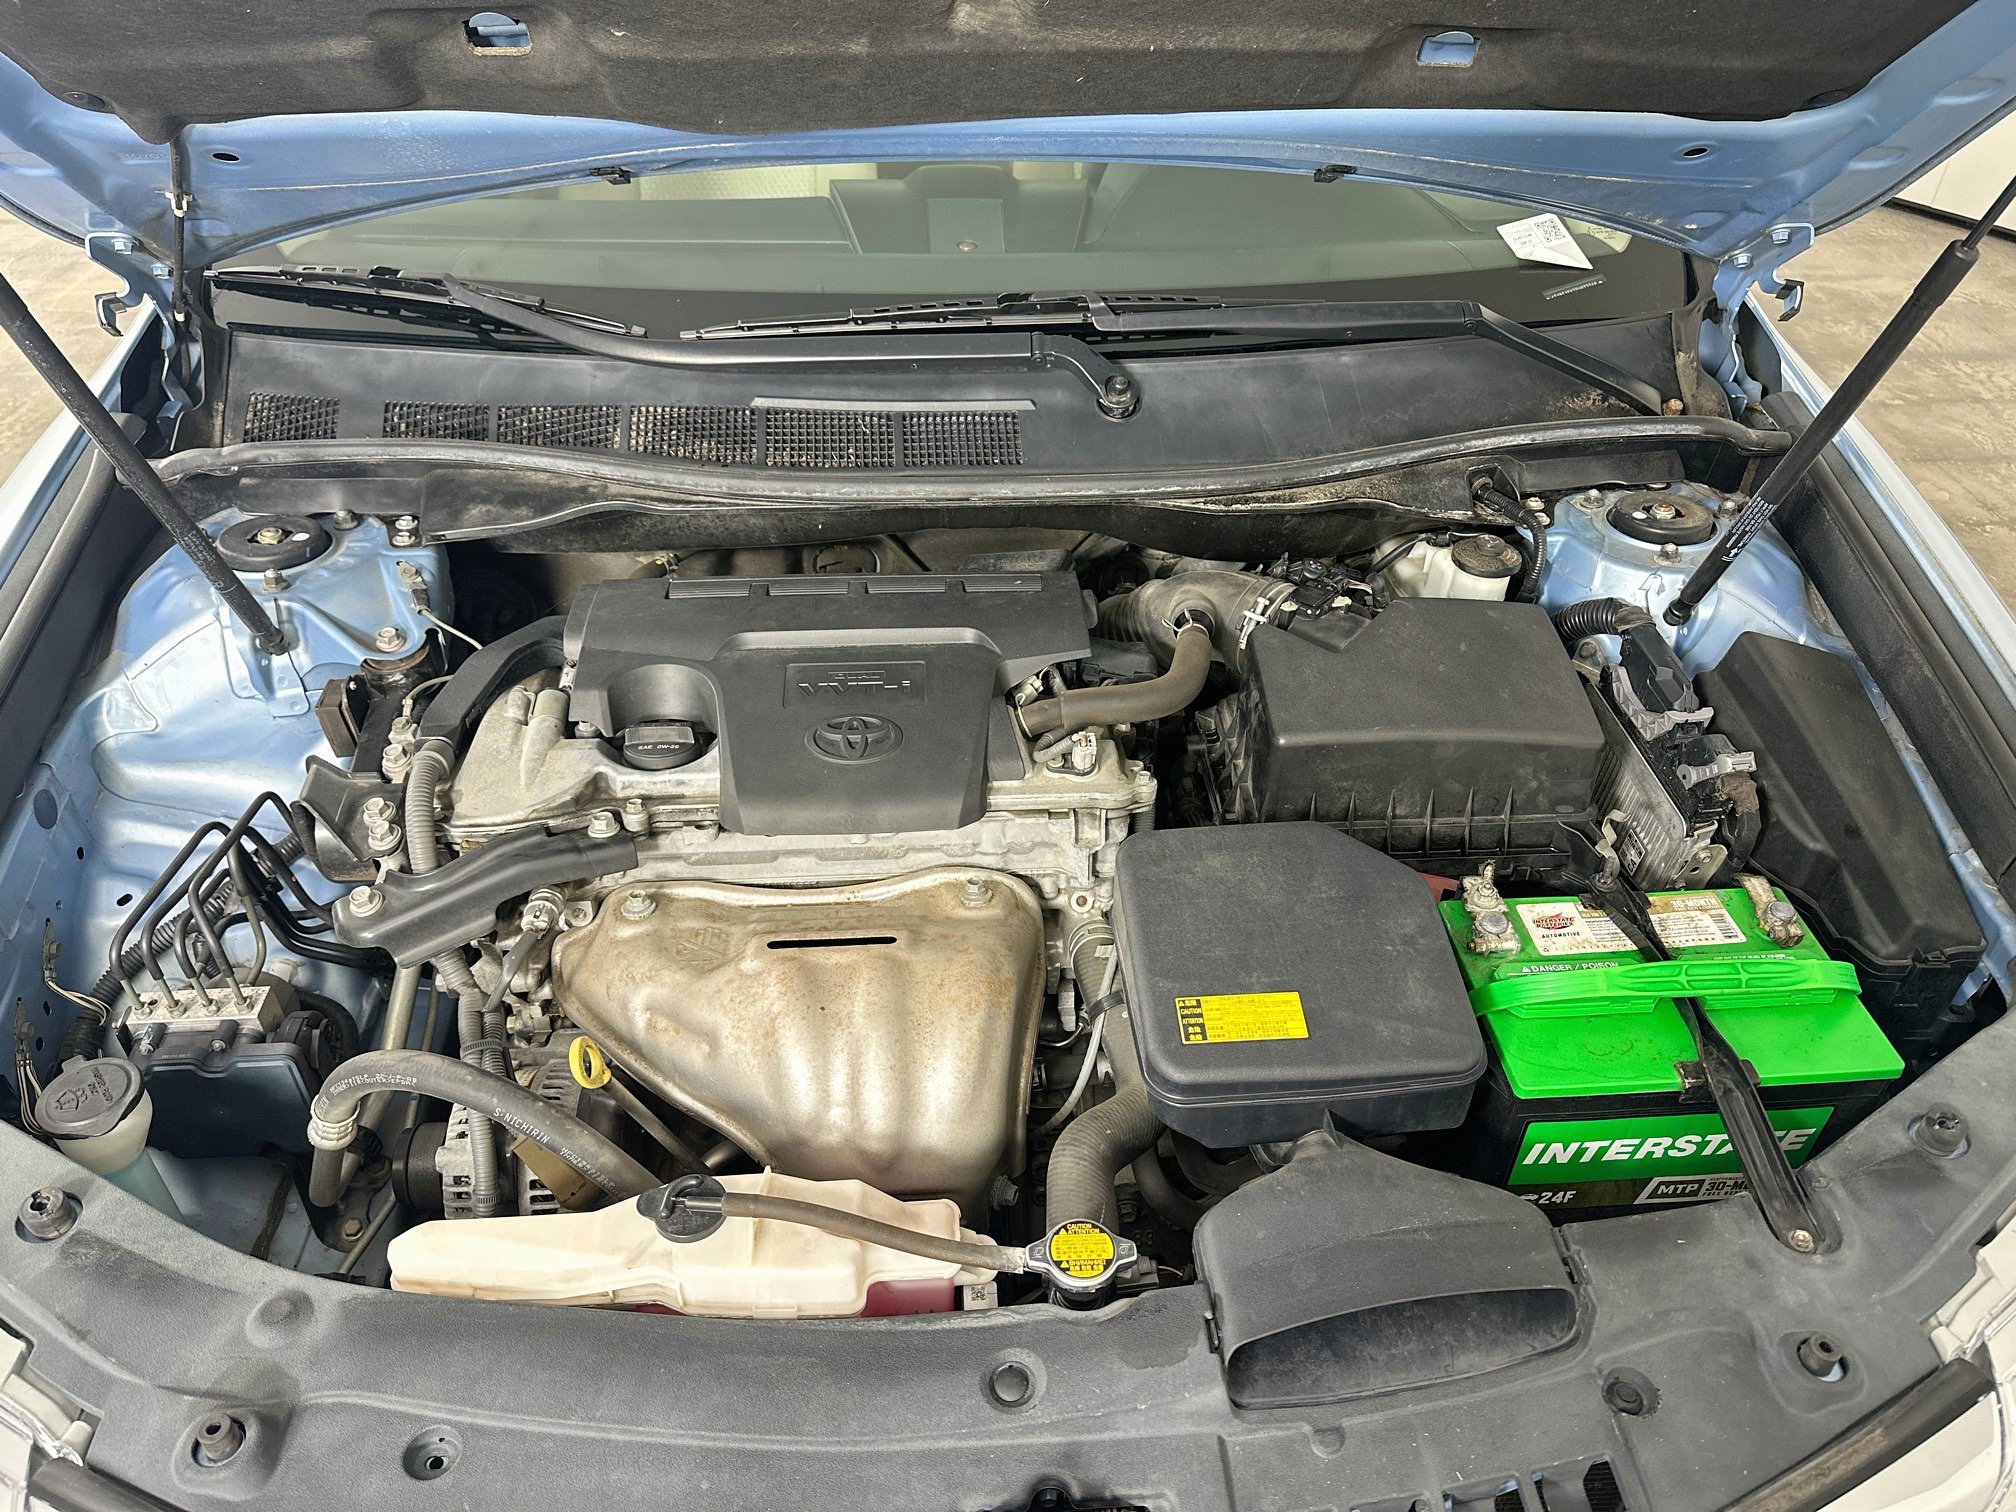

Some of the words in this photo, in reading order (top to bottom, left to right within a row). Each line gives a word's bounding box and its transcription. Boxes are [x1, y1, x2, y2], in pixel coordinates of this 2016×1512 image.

[1531, 964, 1572, 972] DANGER
[1522, 1128, 1816, 1165] INTERSTE
[1538, 1191, 1577, 1204] 24F
[1657, 1184, 1699, 1194] MTP
